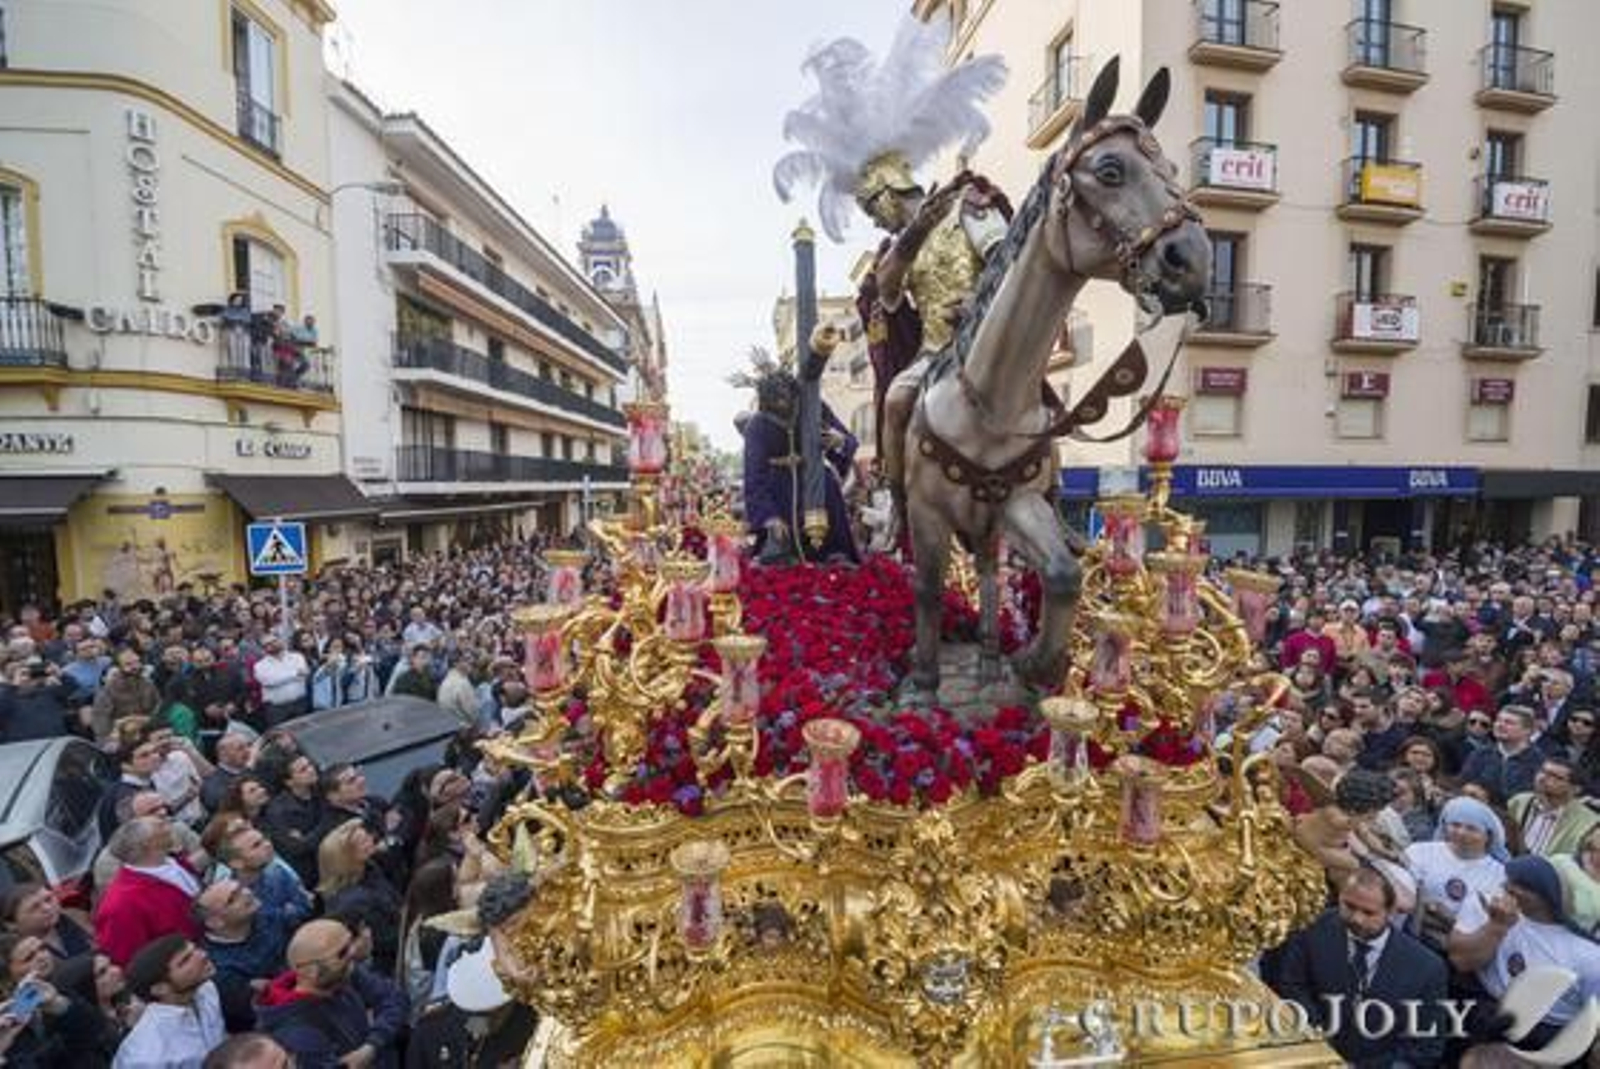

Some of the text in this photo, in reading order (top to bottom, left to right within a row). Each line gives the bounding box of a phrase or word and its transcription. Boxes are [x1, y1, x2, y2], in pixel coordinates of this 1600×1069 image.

[127, 110, 161, 302] HOSTAL
[1196, 468, 1243, 488] BBVA
[1409, 469, 1449, 488] BBVA
